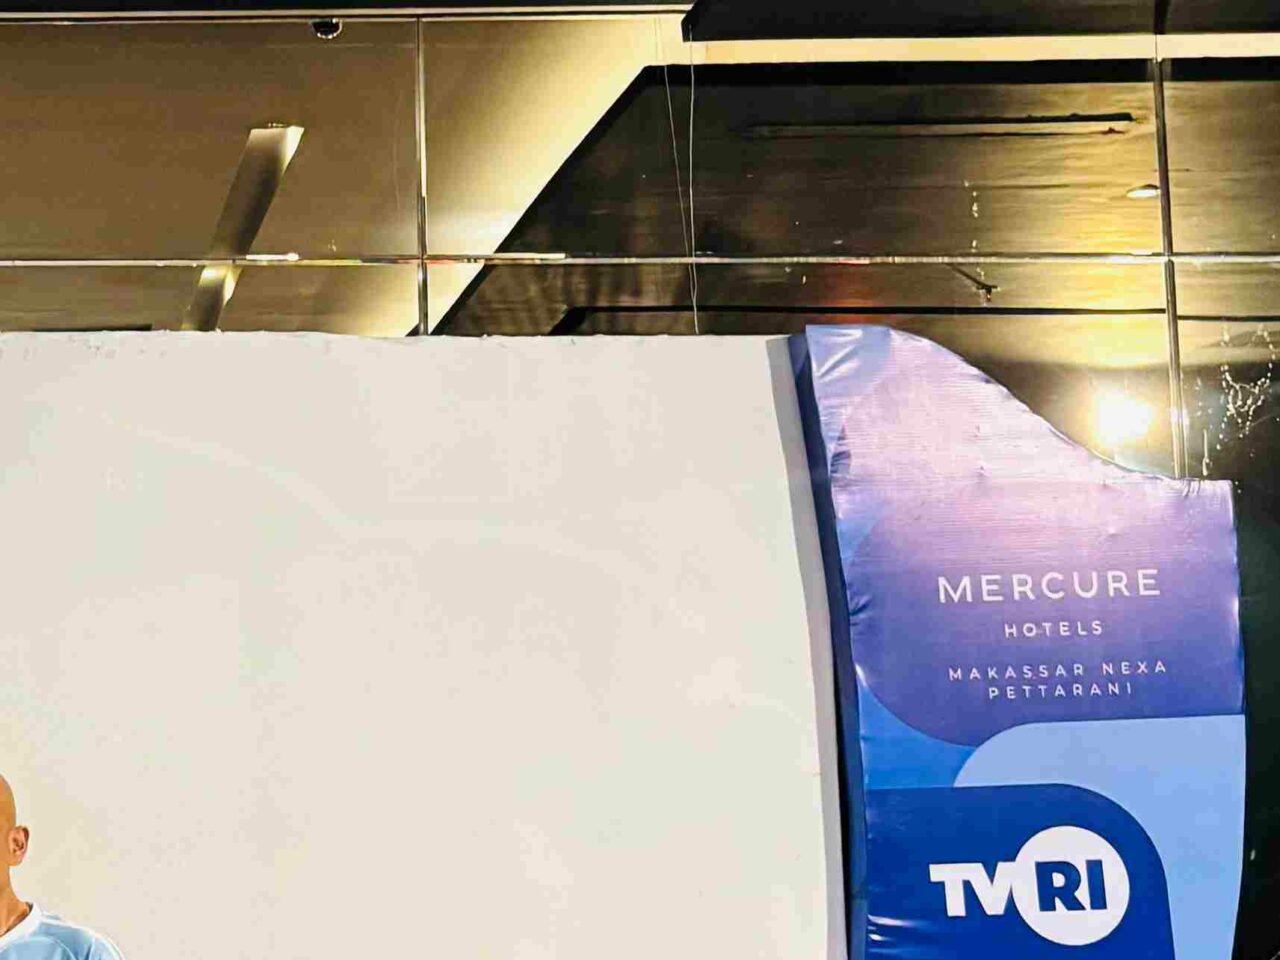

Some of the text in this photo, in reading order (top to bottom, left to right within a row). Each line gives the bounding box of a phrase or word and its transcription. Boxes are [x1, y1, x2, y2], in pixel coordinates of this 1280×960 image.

[938, 568, 1161, 603] MERCURE
[1004, 620, 1103, 638] HOTELS
[948, 660, 1167, 681] MAKASSAR NEXA
[988, 682, 1132, 699] PETTARANI
